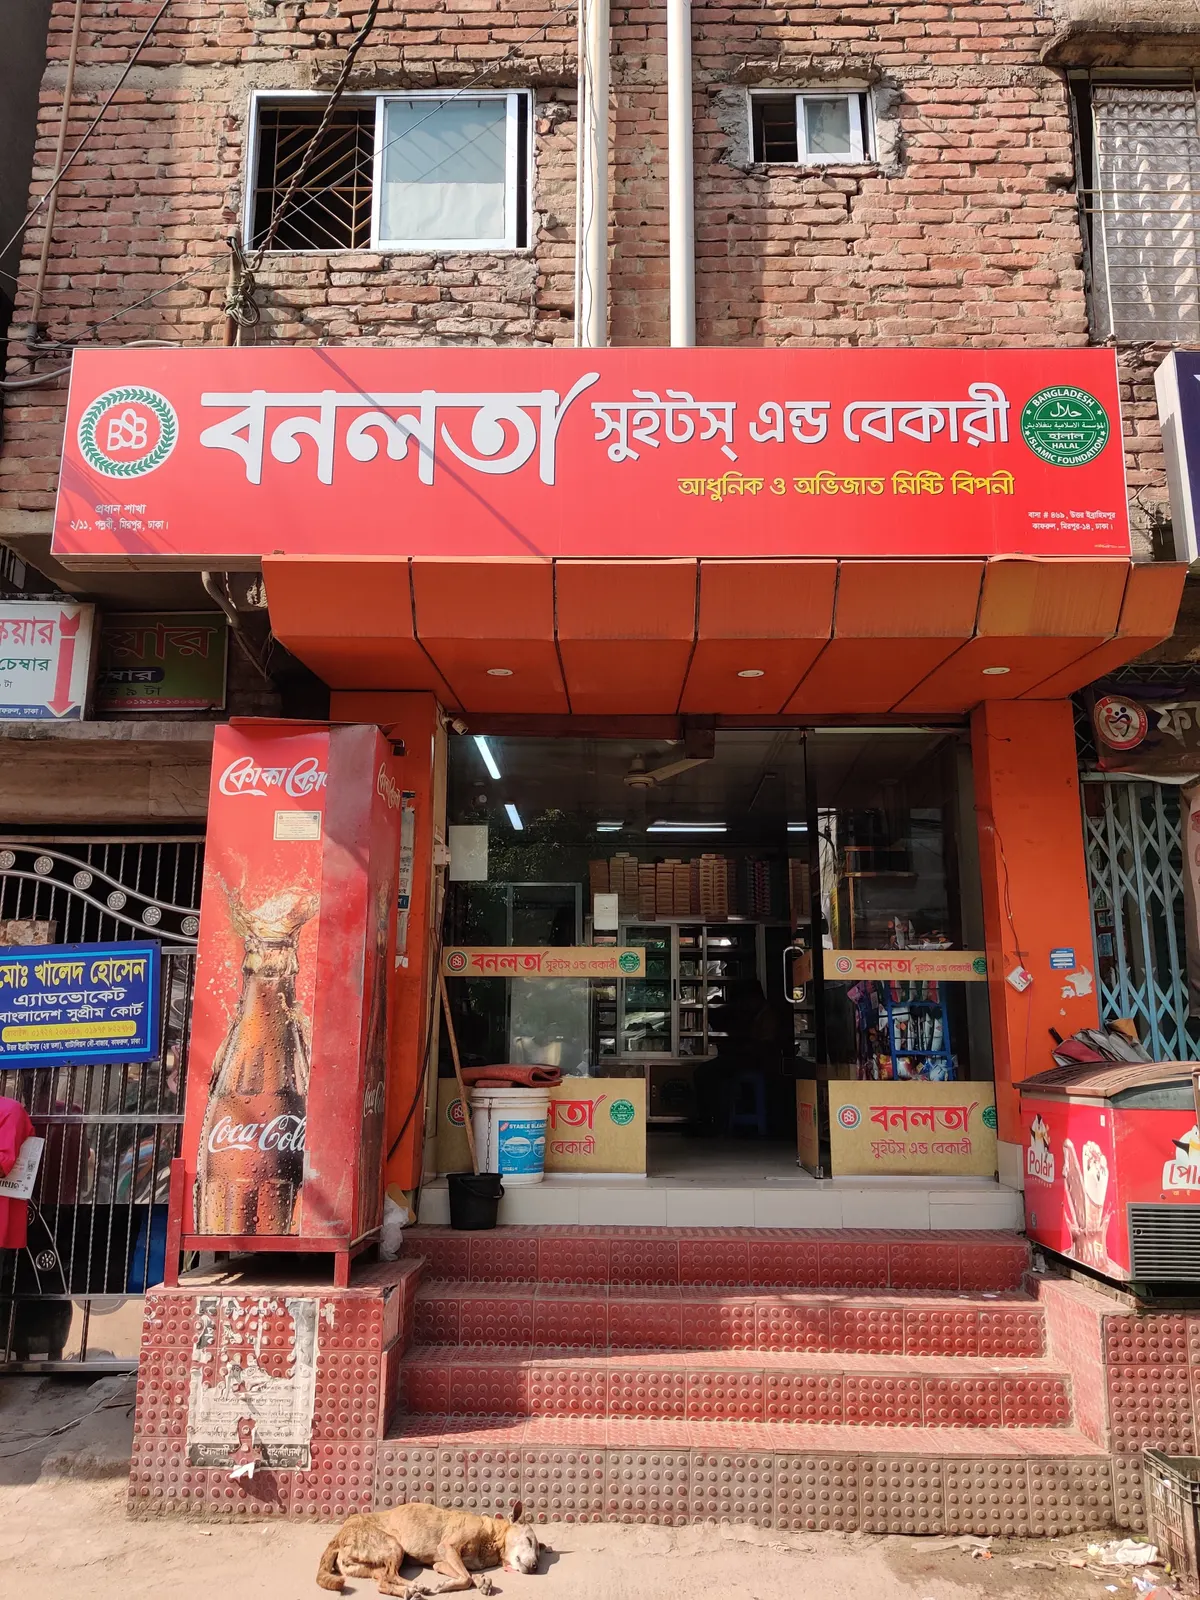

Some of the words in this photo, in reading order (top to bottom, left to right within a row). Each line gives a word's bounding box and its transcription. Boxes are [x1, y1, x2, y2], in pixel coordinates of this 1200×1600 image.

[1031, 388, 1095, 407] BANGLADESH
[200, 371, 601, 486] বনলতা
[590, 388, 739, 462] সুইটস্
[749, 400, 830, 443] এন্ড
[844, 381, 1010, 448] বেকারী
[1028, 436, 1057, 462] ISLAMIC
[1057, 436, 1105, 465] FOUNDATION
[678, 471, 764, 502] আধুনিক
[770, 477, 786, 496] ও
[793, 471, 886, 496] অভিজাত
[891, 470, 944, 496] মিষ্টি
[950, 470, 1015, 496] বিপনী
[124, 503, 147, 514] শাখা
[34, 960, 86, 987] খালেদ
[90, 957, 148, 987] হোসেন
[471, 950, 549, 974] বনলতা
[856, 957, 917, 974] বনলতা
[0, 1009, 62, 1023] বাংলাদেশ
[66, 1004, 106, 1022] সুপ্রীম
[110, 1002, 144, 1018] কোর্ট
[869, 1101, 980, 1133] বনলতা
[550, 1135, 596, 1157] বেকারী
[909, 1141, 928, 1155] এন্ড
[931, 1137, 972, 1156] বেকারী
[1029, 1150, 1053, 1178] Polar
